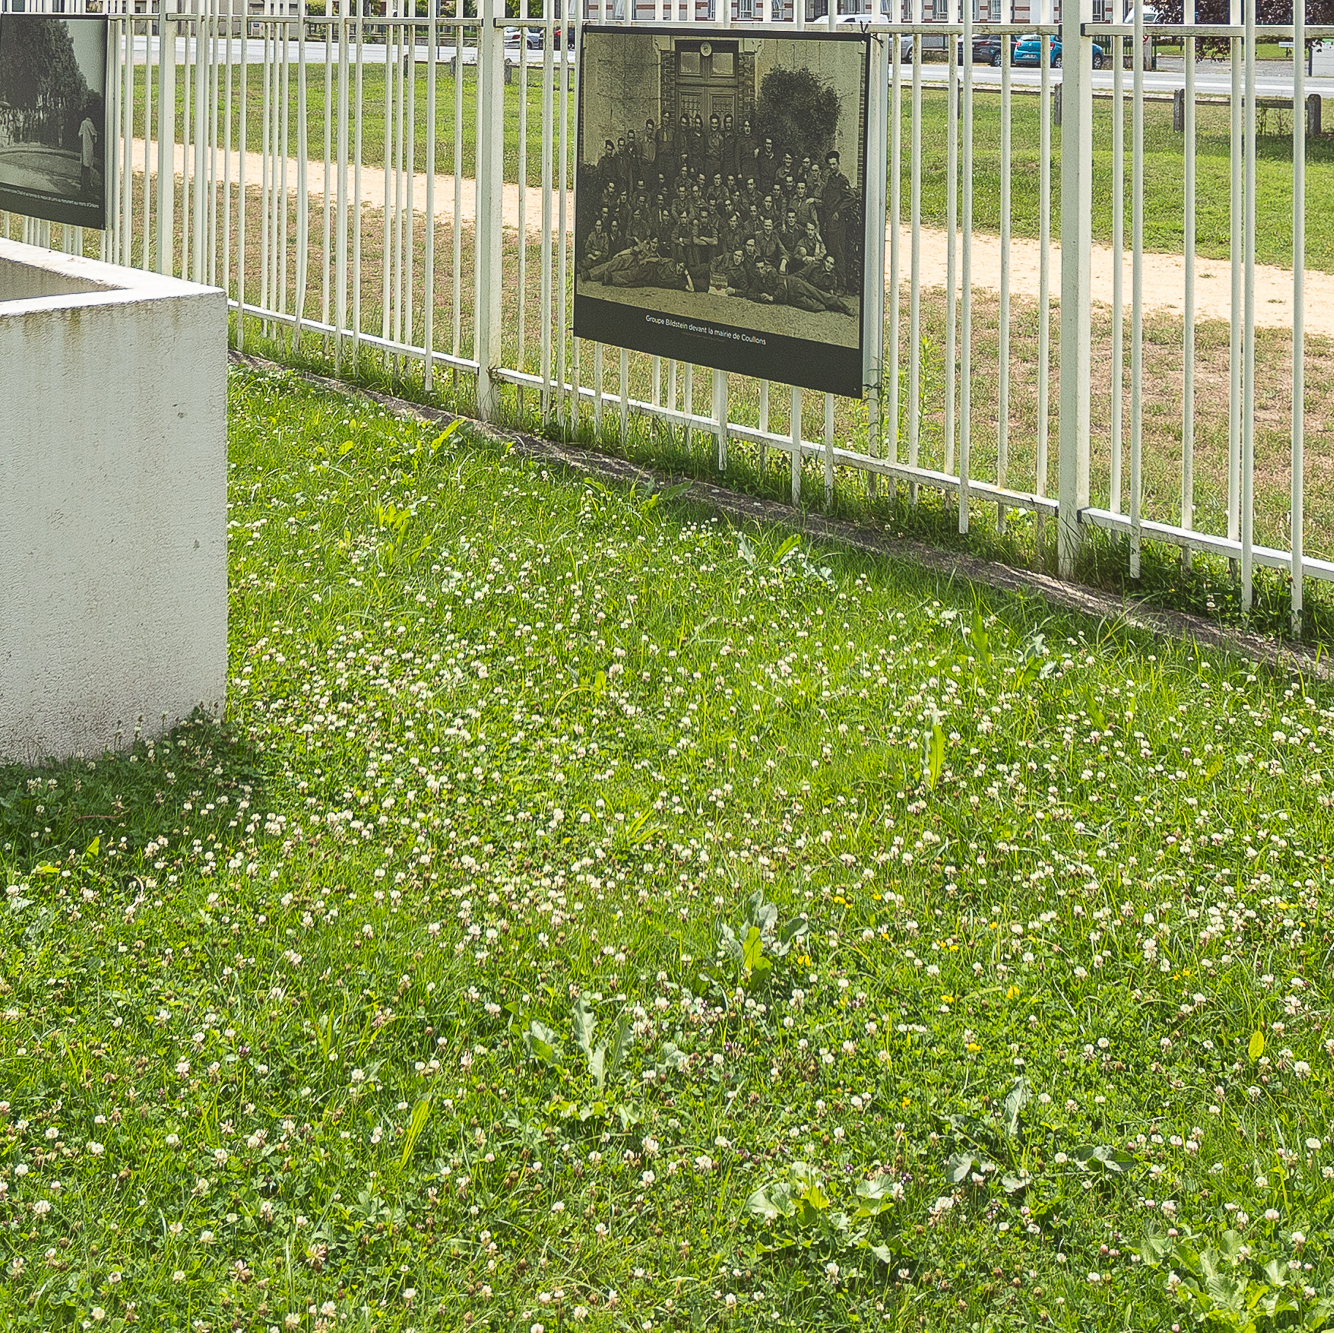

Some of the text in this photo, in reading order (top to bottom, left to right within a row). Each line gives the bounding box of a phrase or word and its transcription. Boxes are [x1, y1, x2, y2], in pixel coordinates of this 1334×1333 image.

[645, 314, 665, 325] Groupe
[665, 318, 688, 330] Bildstein
[688, 324, 707, 334] devant
[708, 327, 714, 335] la
[714, 328, 731, 339] mairie
[732, 331, 740, 341] de
[741, 333, 767, 346] Coullons
